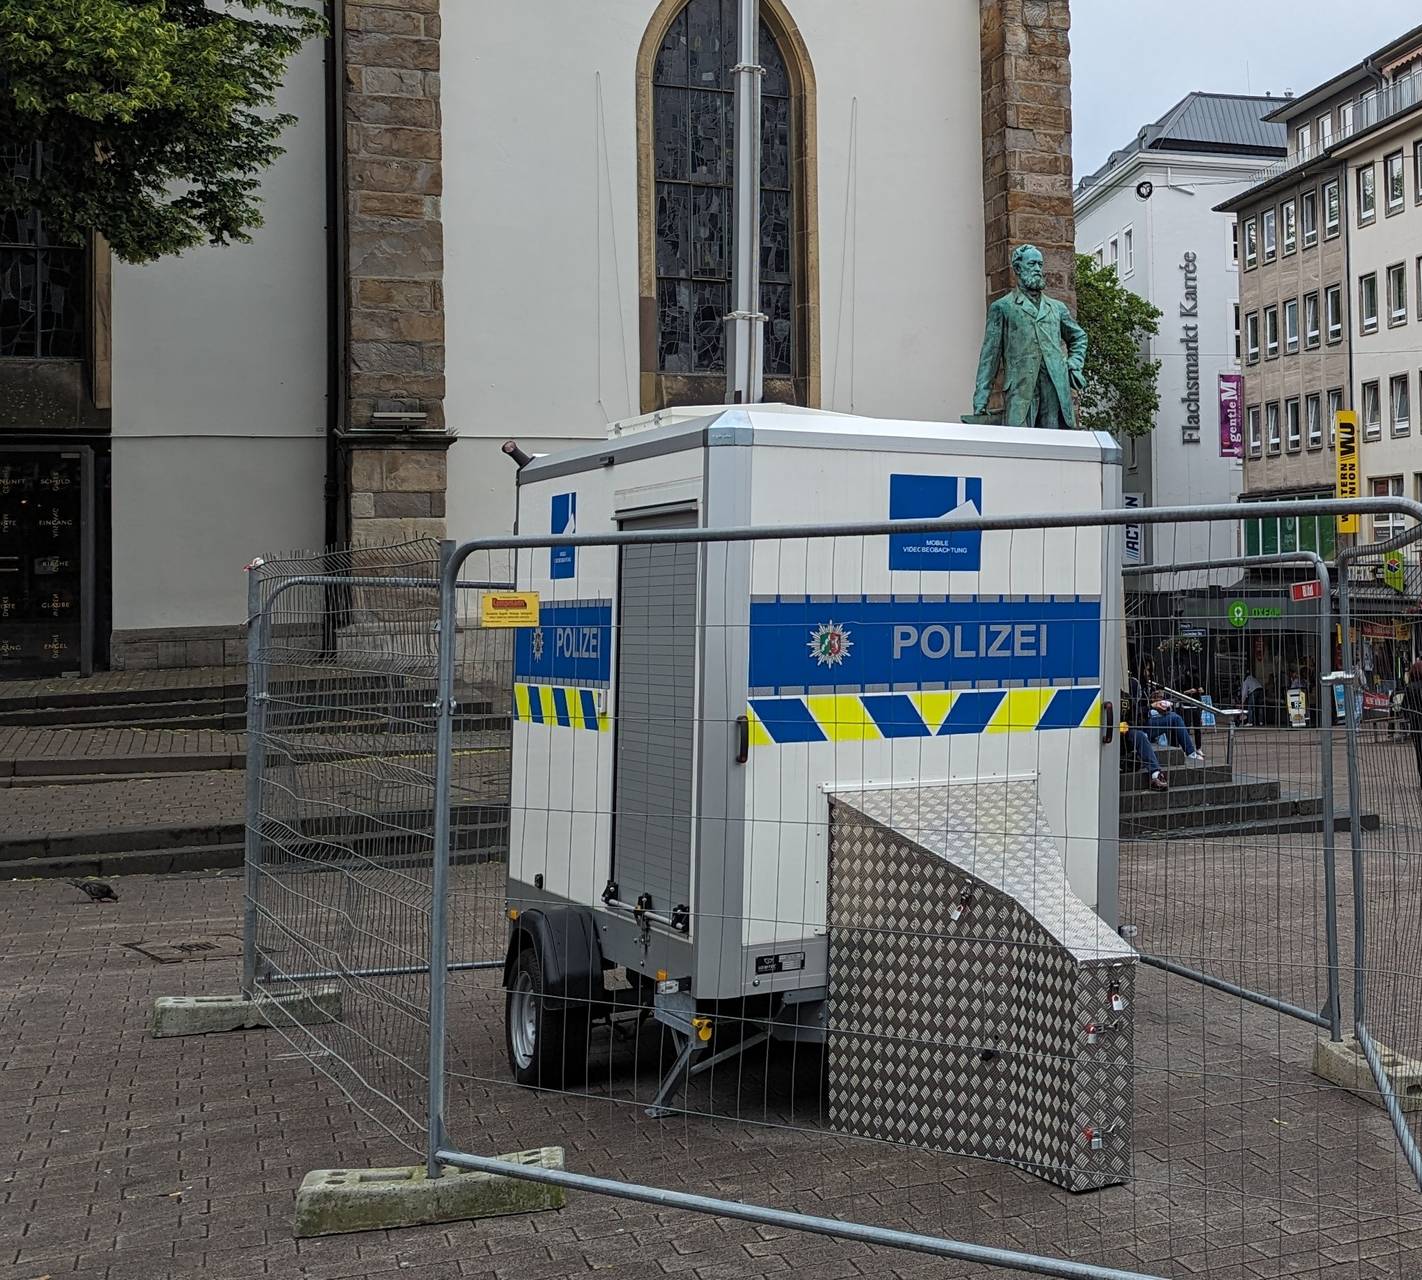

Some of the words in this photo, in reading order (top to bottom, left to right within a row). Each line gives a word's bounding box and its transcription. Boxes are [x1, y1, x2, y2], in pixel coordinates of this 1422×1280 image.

[1178, 250, 1199, 318] Karrée
[1181, 321, 1201, 445] Flachsmarkt
[1341, 463, 1349, 522] WTERN
[1348, 463, 1356, 498] NION
[1126, 496, 1139, 551] ACTN
[556, 627, 601, 659] POLIZEI
[893, 624, 1048, 660] POLIZEI
